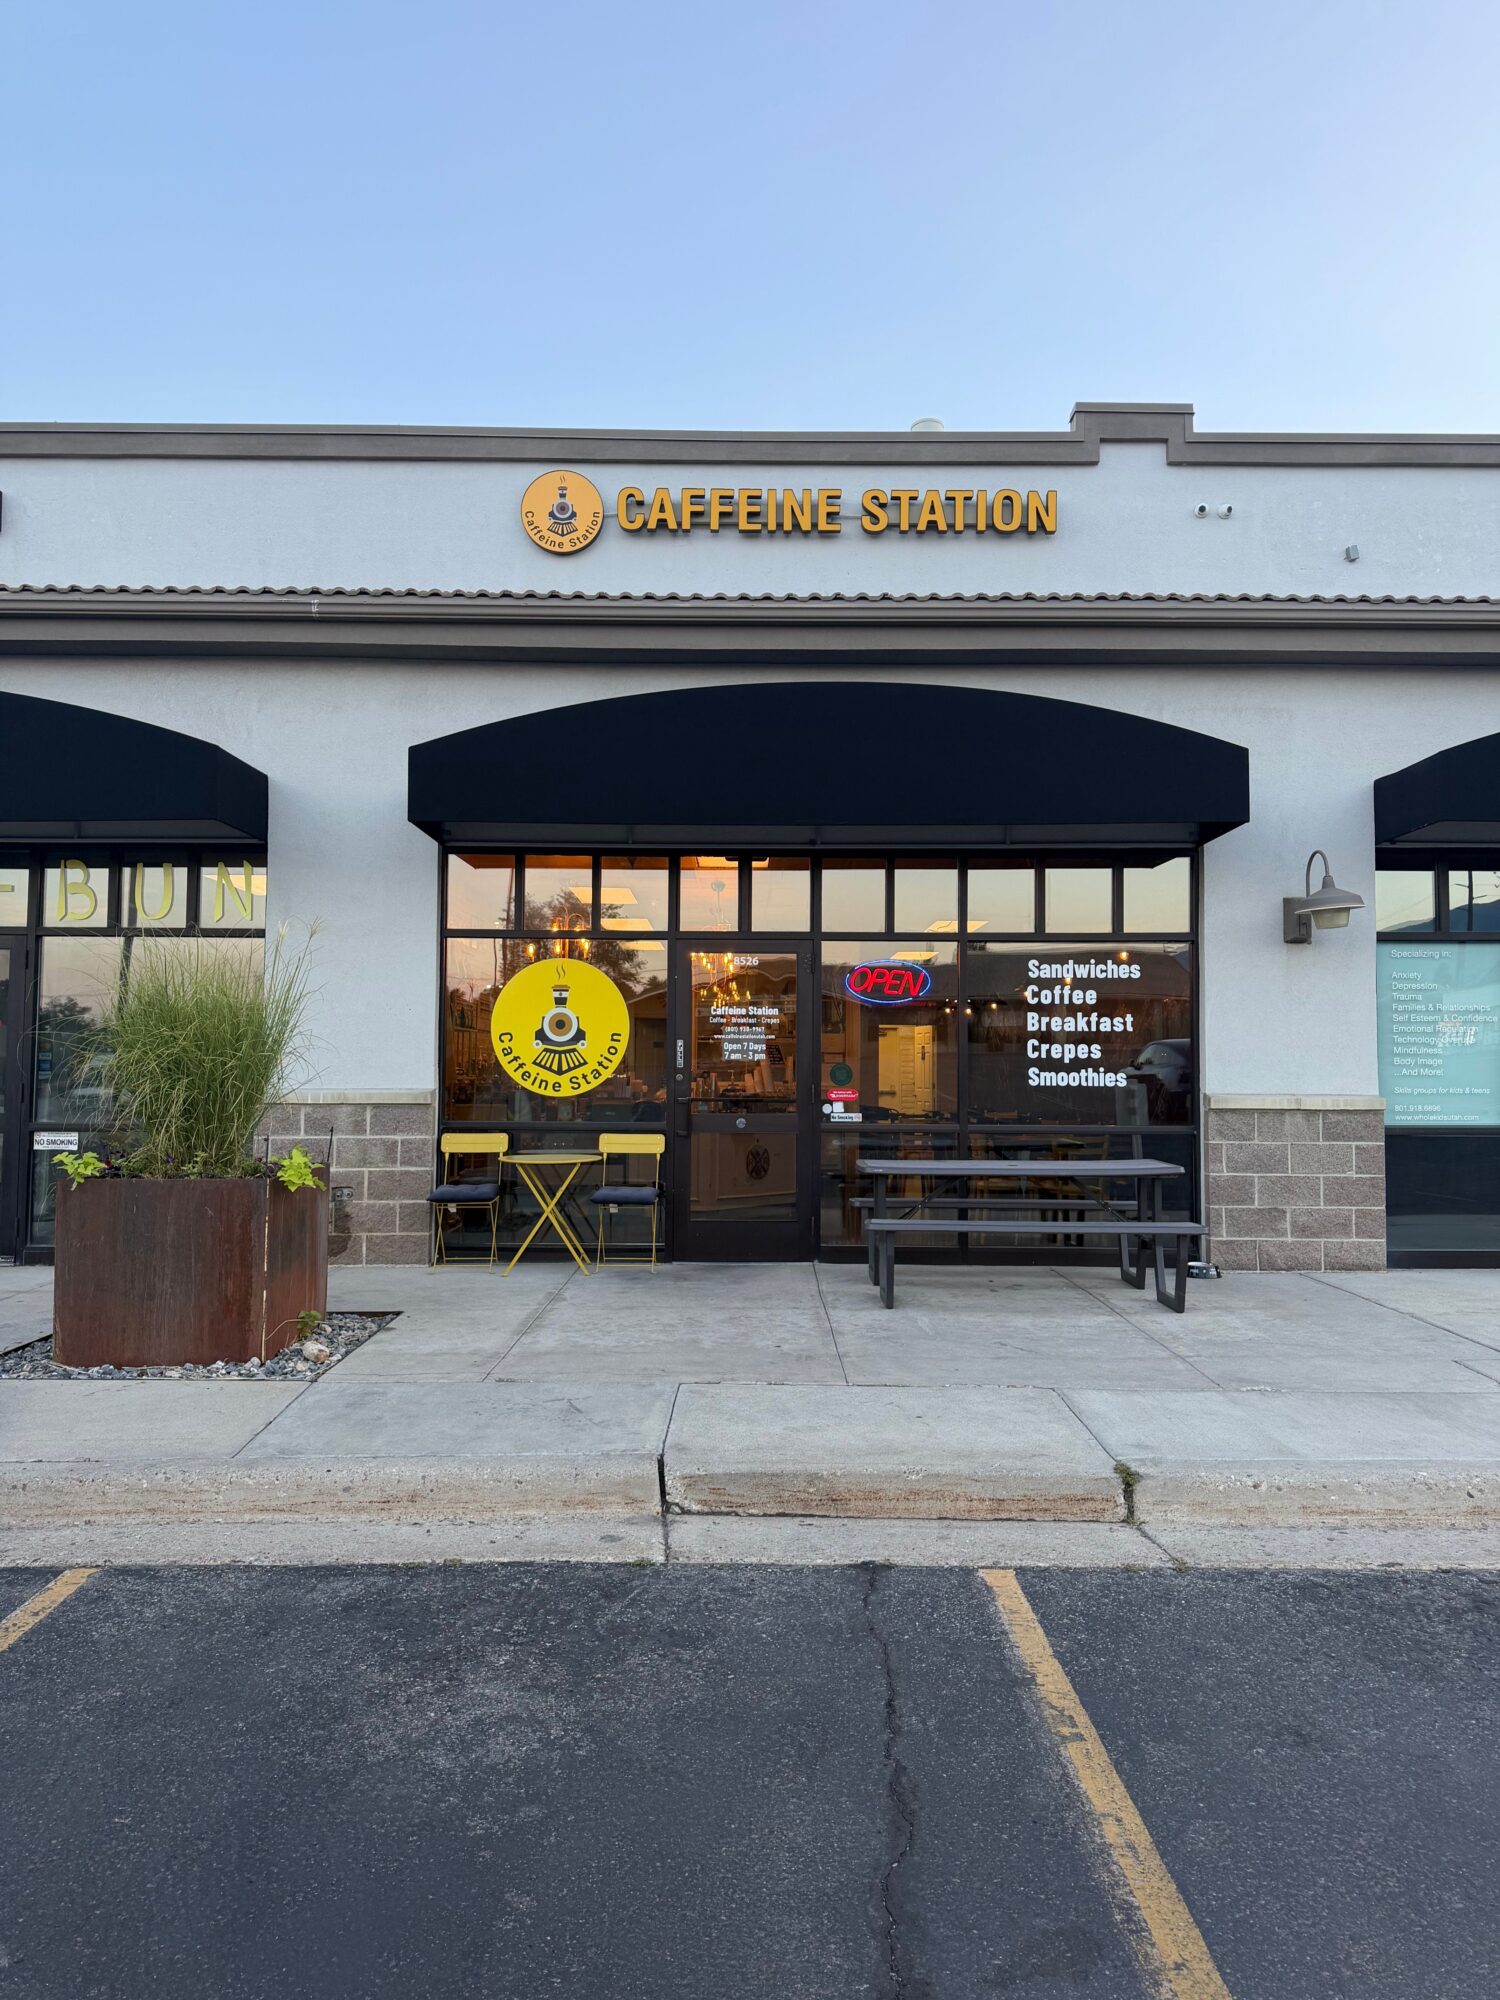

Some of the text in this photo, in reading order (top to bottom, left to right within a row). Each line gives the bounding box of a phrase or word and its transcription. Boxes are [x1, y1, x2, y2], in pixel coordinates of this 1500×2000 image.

[616, 486, 1057, 534] CAFFEINE STATION
[525, 511, 600, 548] Caffeine Station
[1392, 949, 1452, 959] Specializing in:
[734, 956, 759, 966] 8526
[1028, 959, 1141, 979] Sandwiches
[1392, 971, 1422, 980] Anxiety
[849, 967, 925, 996] OPEN
[1392, 982, 1438, 991] Depression
[1026, 984, 1098, 1005] Coffee
[1392, 993, 1422, 1001] Trauma
[710, 1006, 779, 1015] Caffeine Station
[1436, 1004, 1491, 1012] Relationships
[1026, 1012, 1134, 1032] Breakfast
[1393, 1025, 1433, 1033] Emotional
[1393, 1035, 1438, 1045] Technology
[724, 1042, 741, 1051] Open
[749, 1042, 766, 1051] Days
[1026, 1038, 1102, 1063] Crepes
[499, 1032, 622, 1092] Caffeine Station
[1394, 1058, 1443, 1066] Body Image
[1028, 1067, 1127, 1087] Smoothies
